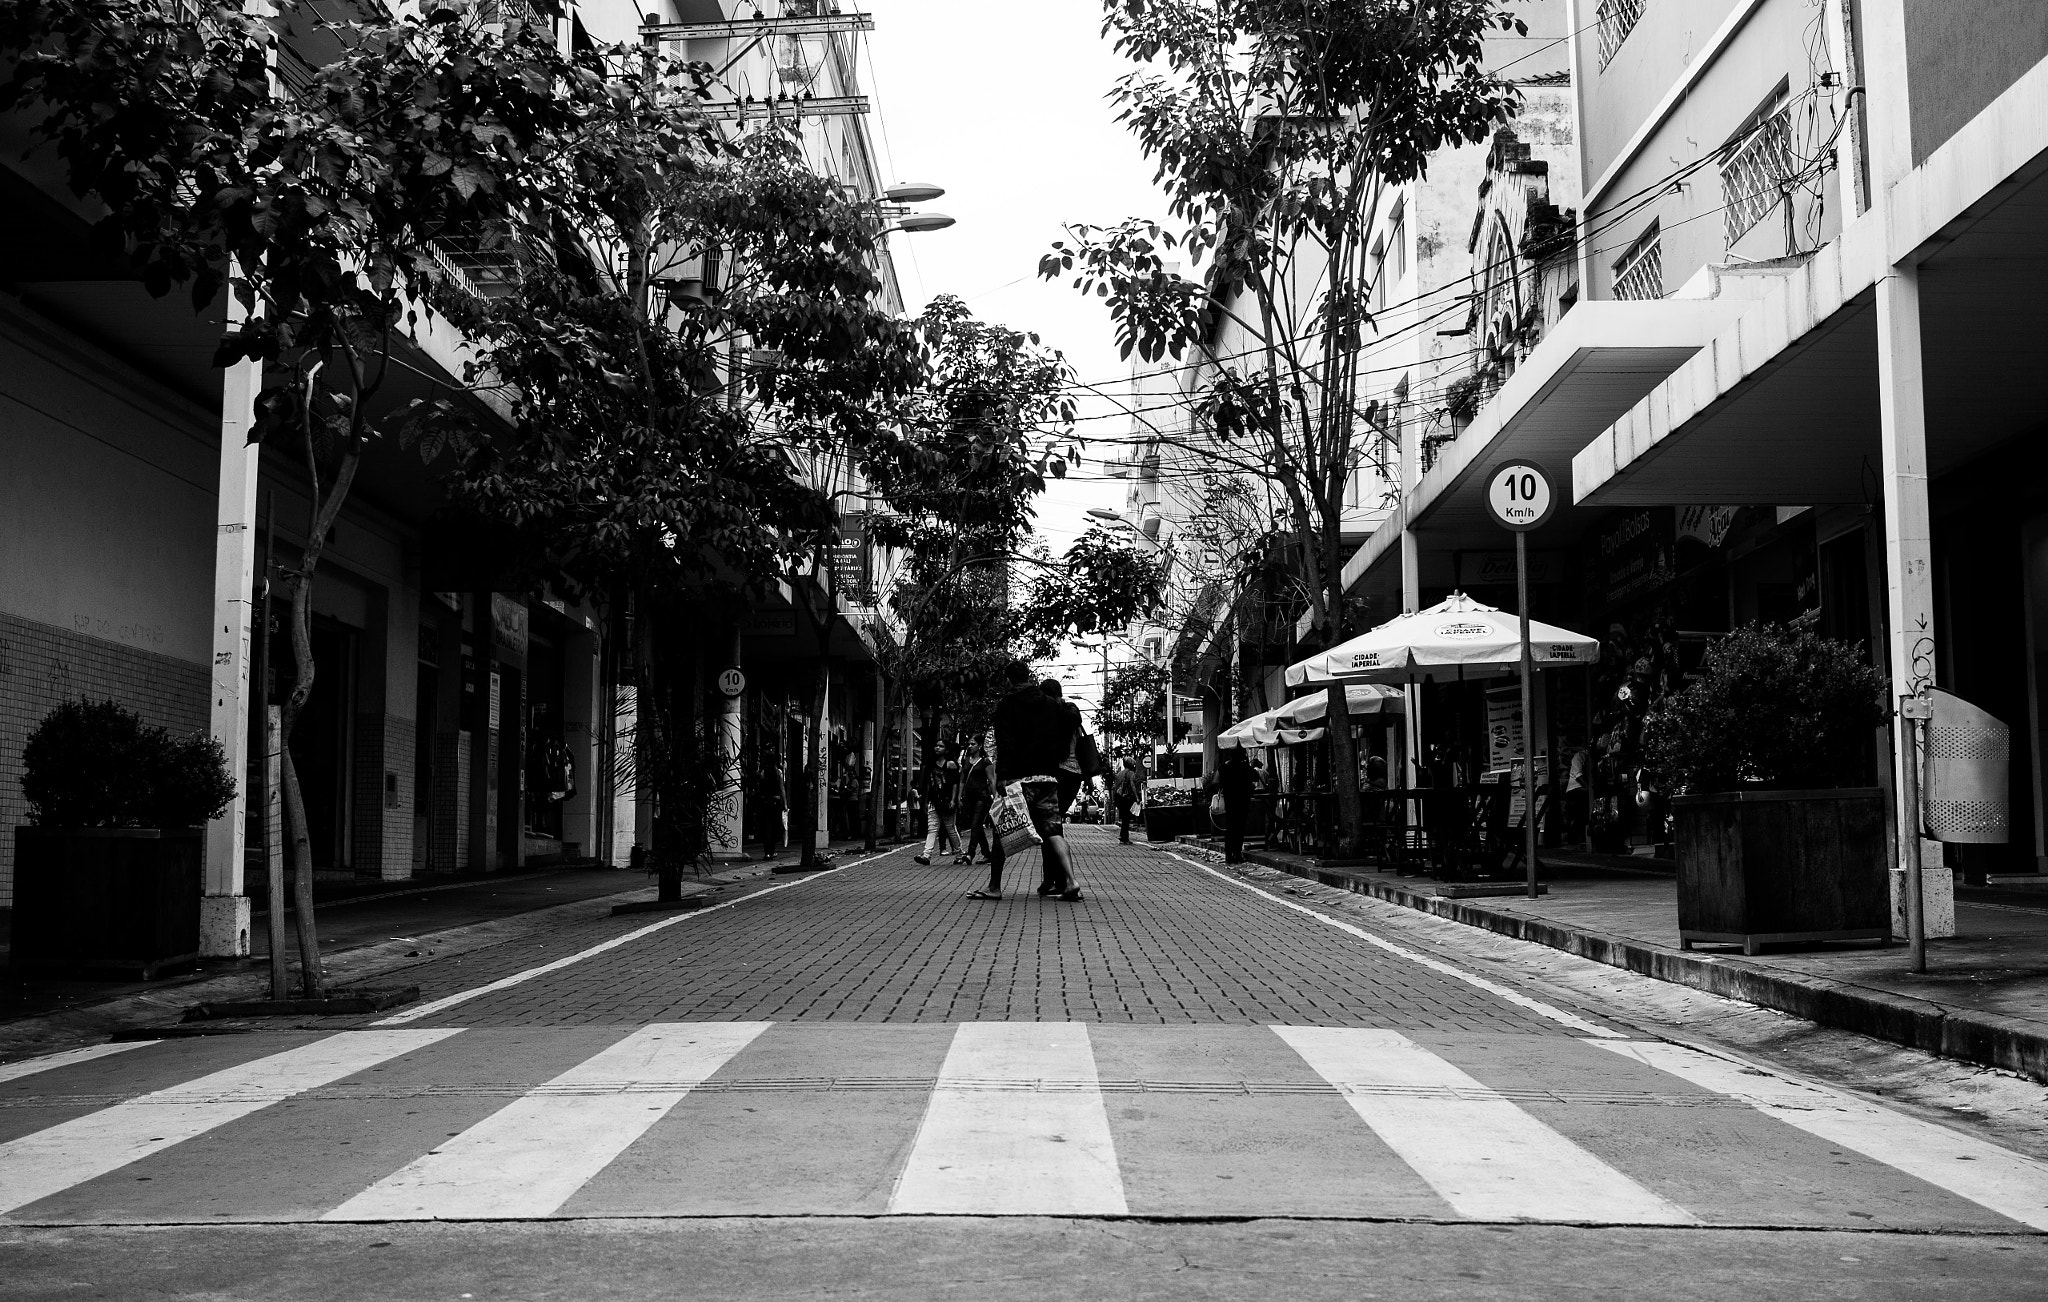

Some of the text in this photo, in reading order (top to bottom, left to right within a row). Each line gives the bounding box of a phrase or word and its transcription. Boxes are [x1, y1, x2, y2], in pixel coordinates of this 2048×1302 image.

[1504, 474, 1536, 501] 10
[1506, 507, 1534, 517] Km/h
[1625, 510, 1650, 542] Bolsas
[1352, 660, 1380, 668] IMPERIAL
[725, 672, 740, 686] 10
